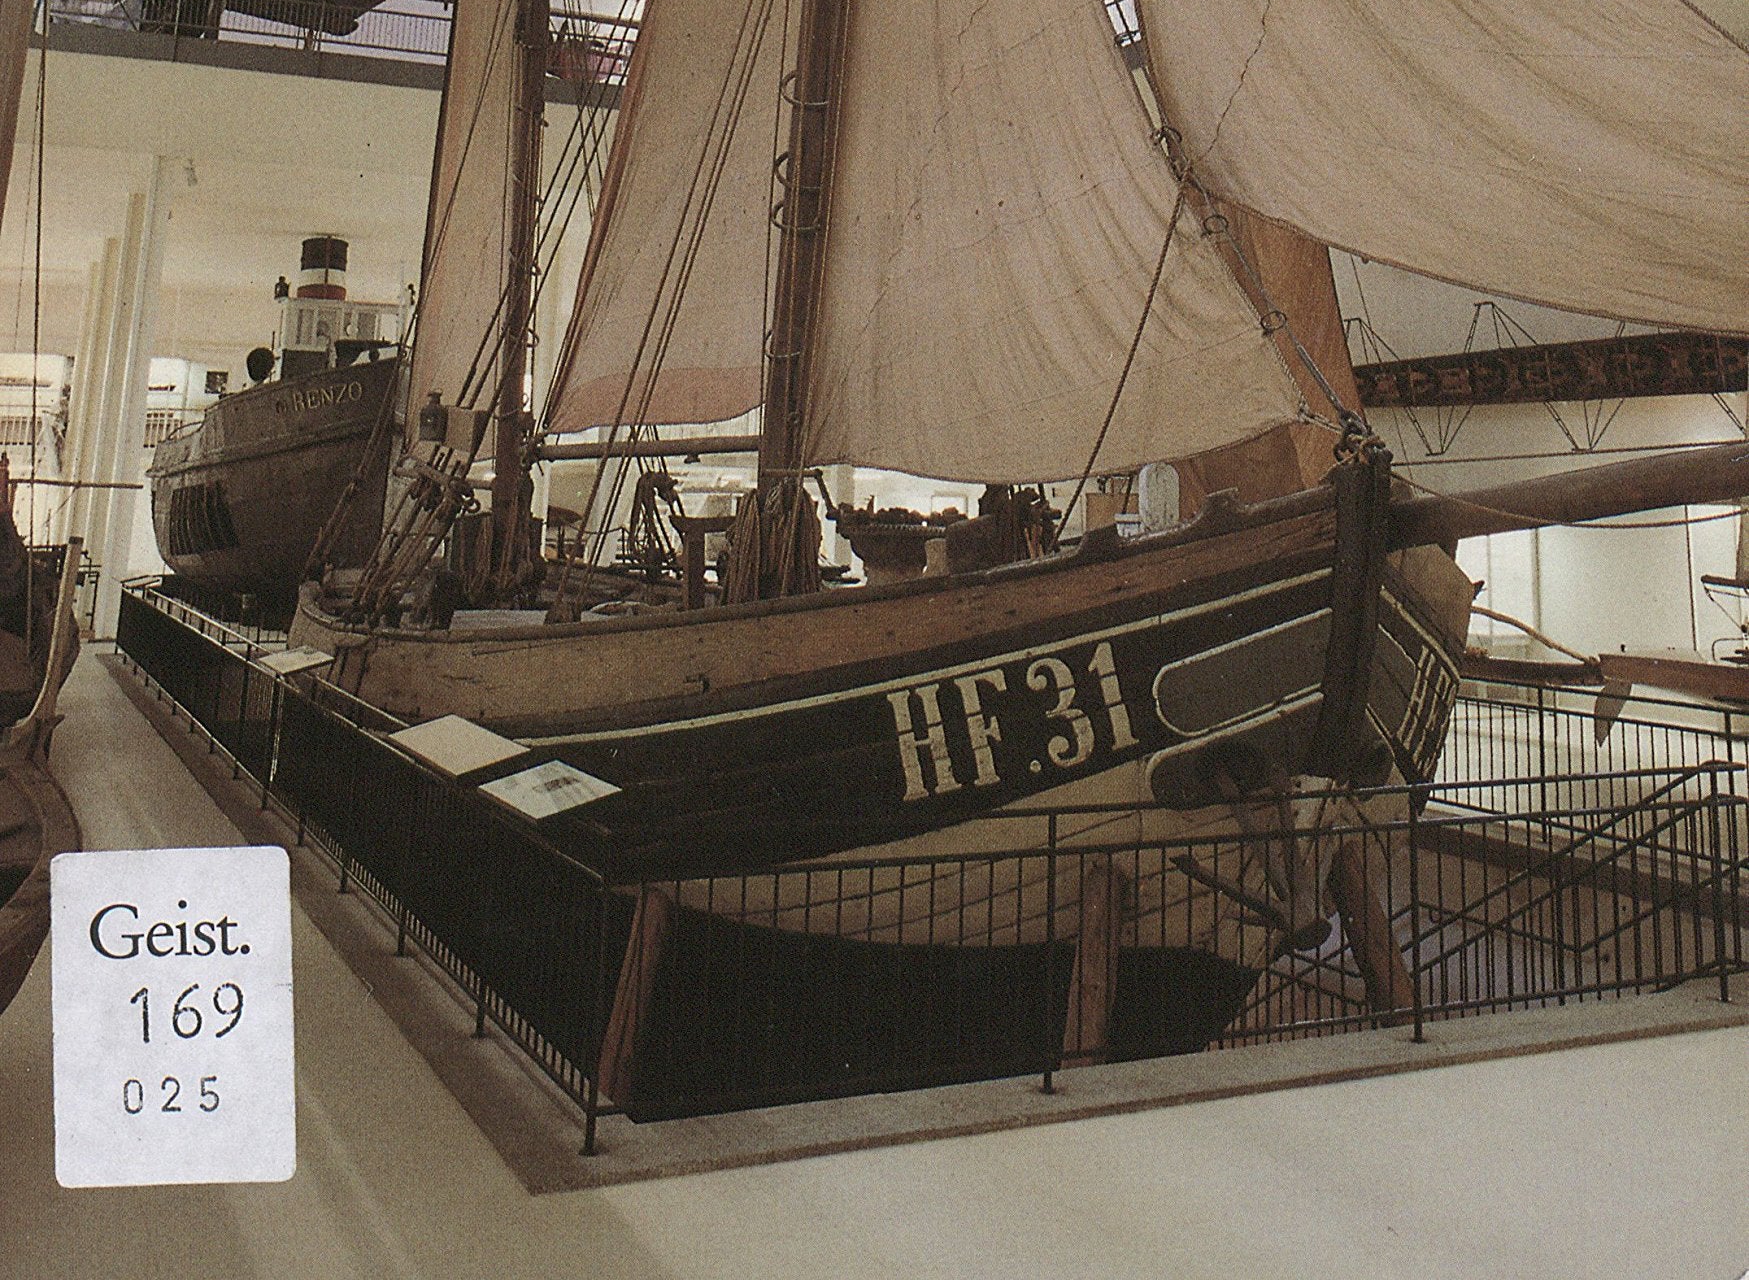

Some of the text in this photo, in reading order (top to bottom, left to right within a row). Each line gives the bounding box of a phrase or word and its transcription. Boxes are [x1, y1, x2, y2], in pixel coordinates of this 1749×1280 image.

[89, 899, 251, 960] Geist.
[130, 983, 245, 1043] 169
[123, 1076, 220, 1115] 025
